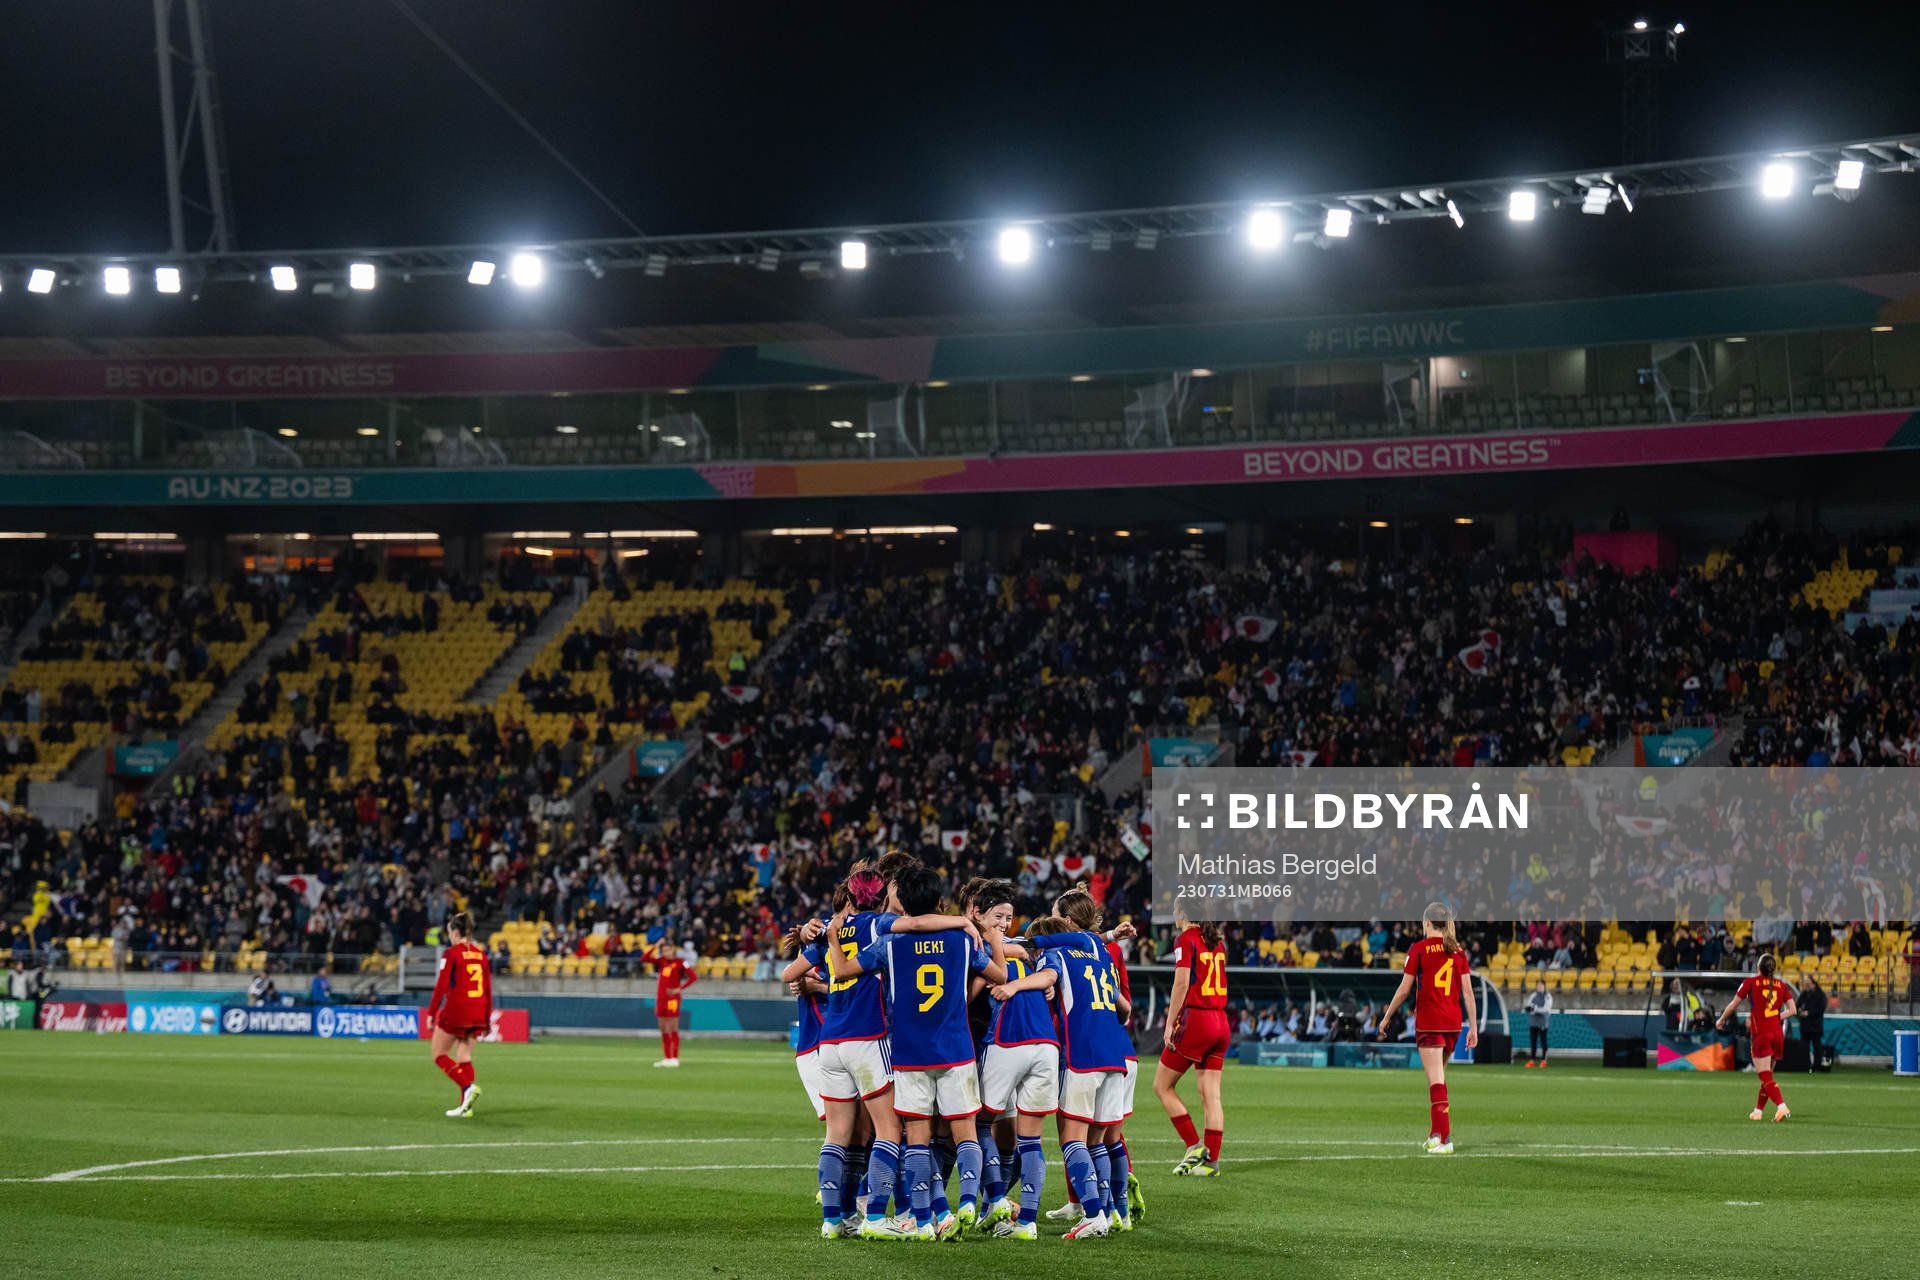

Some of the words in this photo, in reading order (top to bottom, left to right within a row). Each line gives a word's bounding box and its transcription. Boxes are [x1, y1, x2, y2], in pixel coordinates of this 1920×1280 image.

[1305, 320, 1464, 351] #FIFAWWC
[105, 366, 219, 387] BEYOND
[226, 363, 394, 387] GREATNESS
[1243, 449, 1364, 476] BEYOND
[1372, 440, 1549, 471] GREATNESS
[914, 940, 945, 954] UEKI
[466, 963, 483, 998] 3
[916, 963, 944, 1013] 9
[1083, 964, 1117, 1012] 16
[1199, 951, 1228, 996] 20
[1434, 957, 1454, 997] 4
[151, 1006, 196, 1033] xero
[1762, 988, 1779, 1018] 2
[250, 1012, 312, 1032] HYUNDAI
